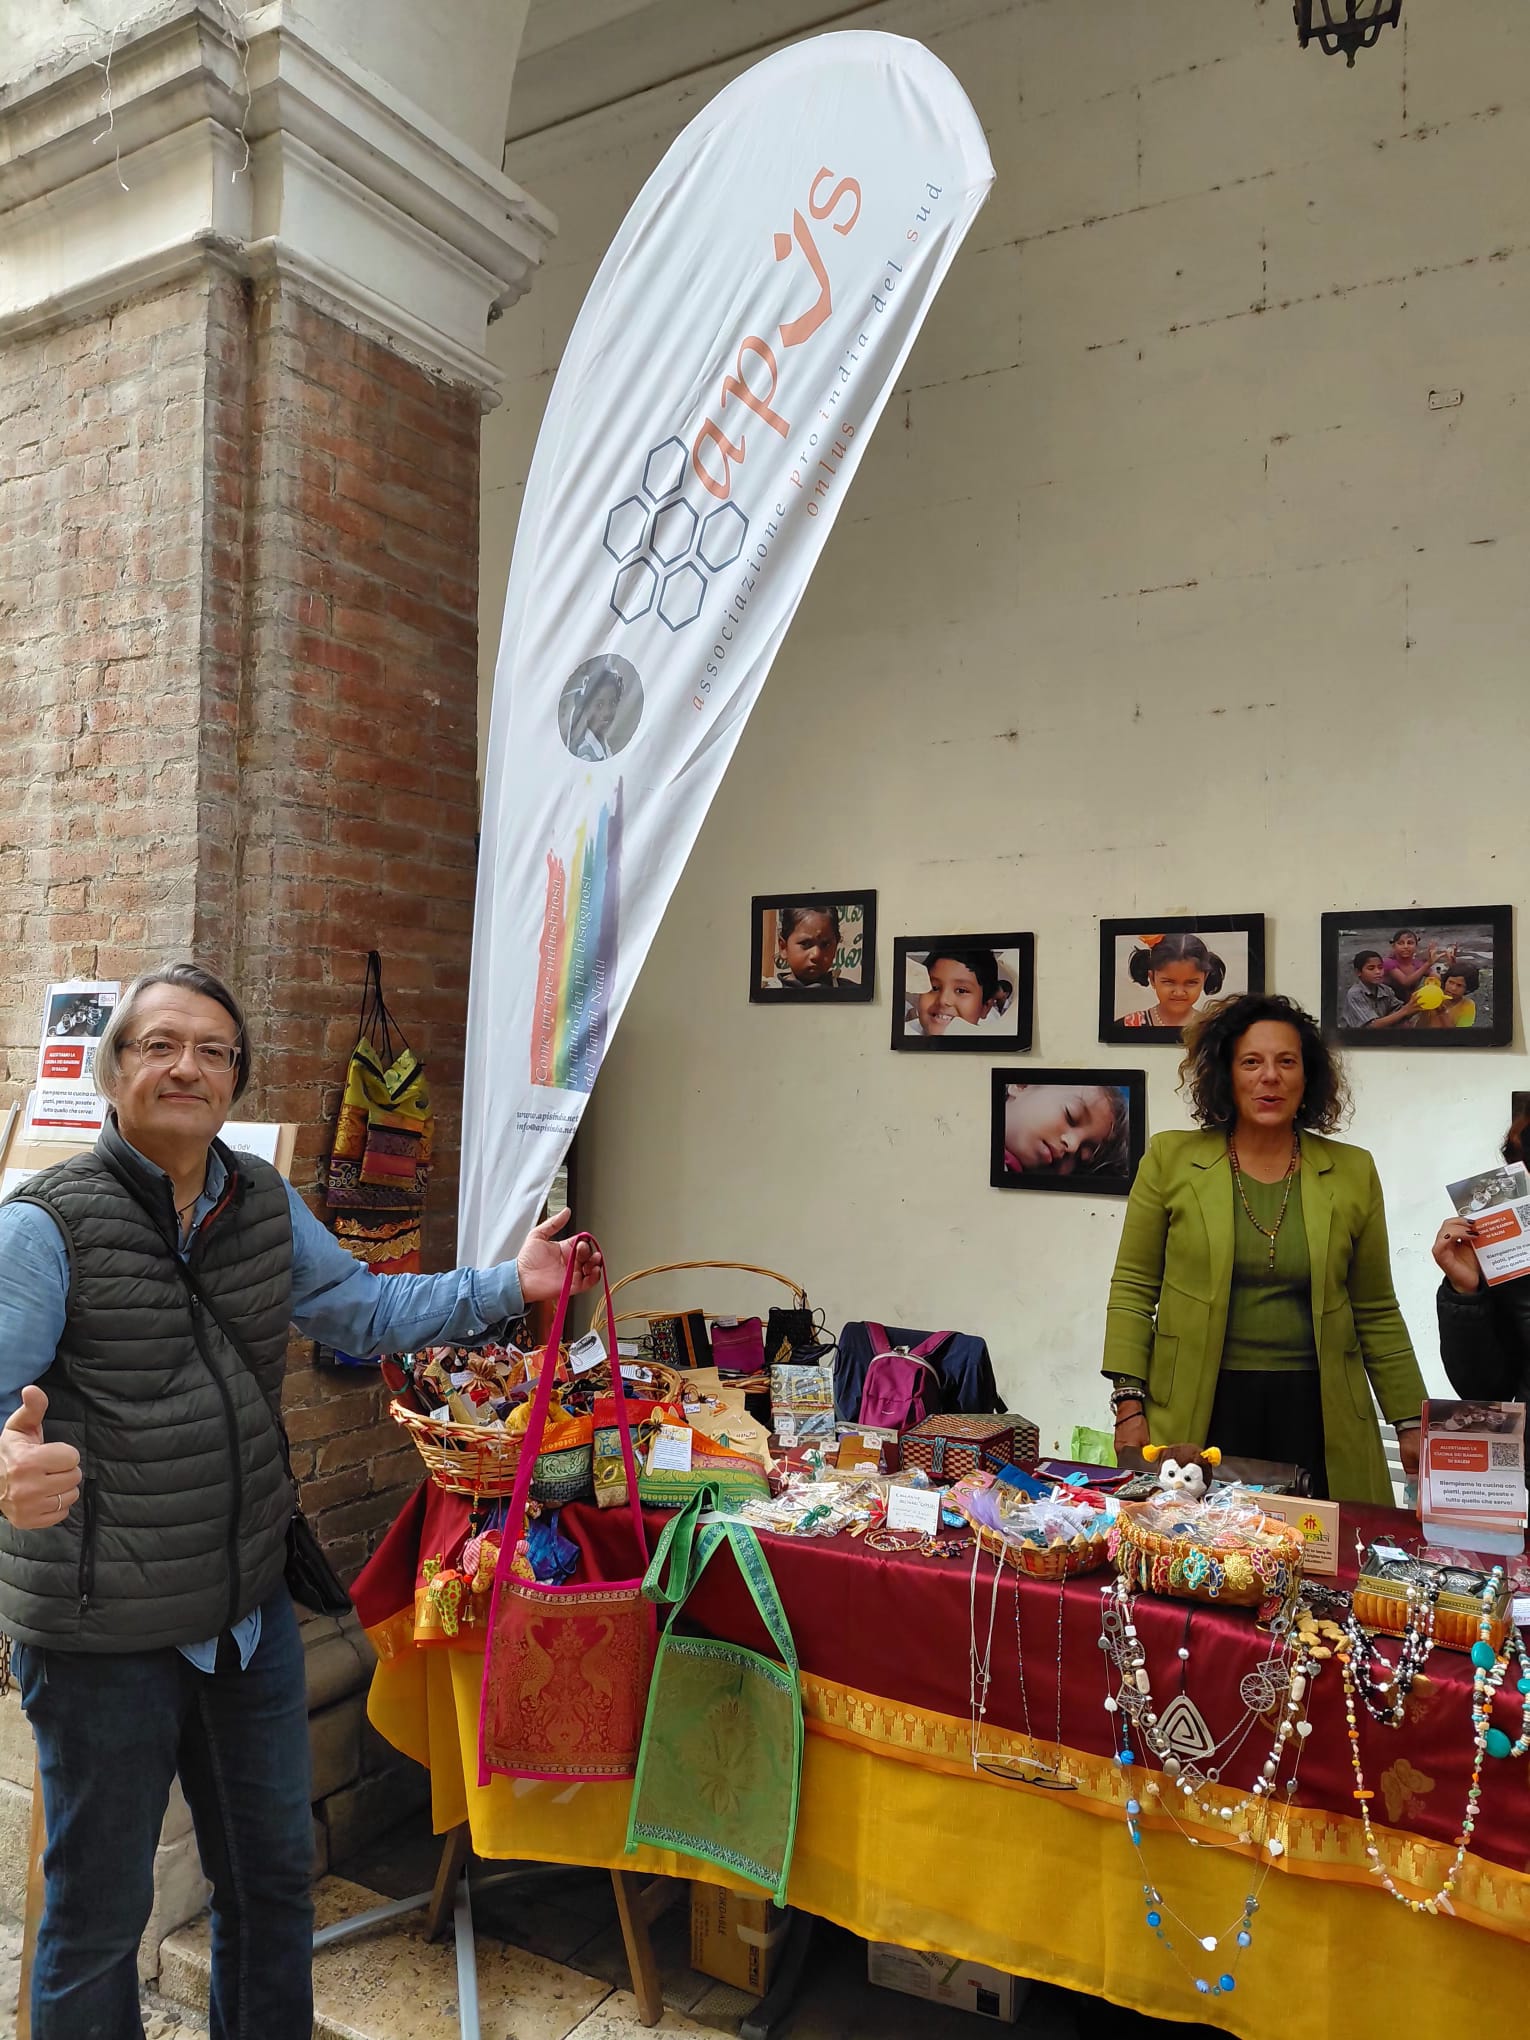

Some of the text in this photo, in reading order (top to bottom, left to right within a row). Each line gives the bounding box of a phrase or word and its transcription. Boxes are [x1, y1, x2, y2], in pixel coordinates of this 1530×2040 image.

[690, 182, 944, 711] associazione pro india del sud
[806, 421, 855, 518] onlus
[570, 990, 585, 1015] dei
[578, 874, 593, 953] bisognosi
[534, 1036, 552, 1082] Come
[583, 959, 606, 1087] del Tamil Nadu
